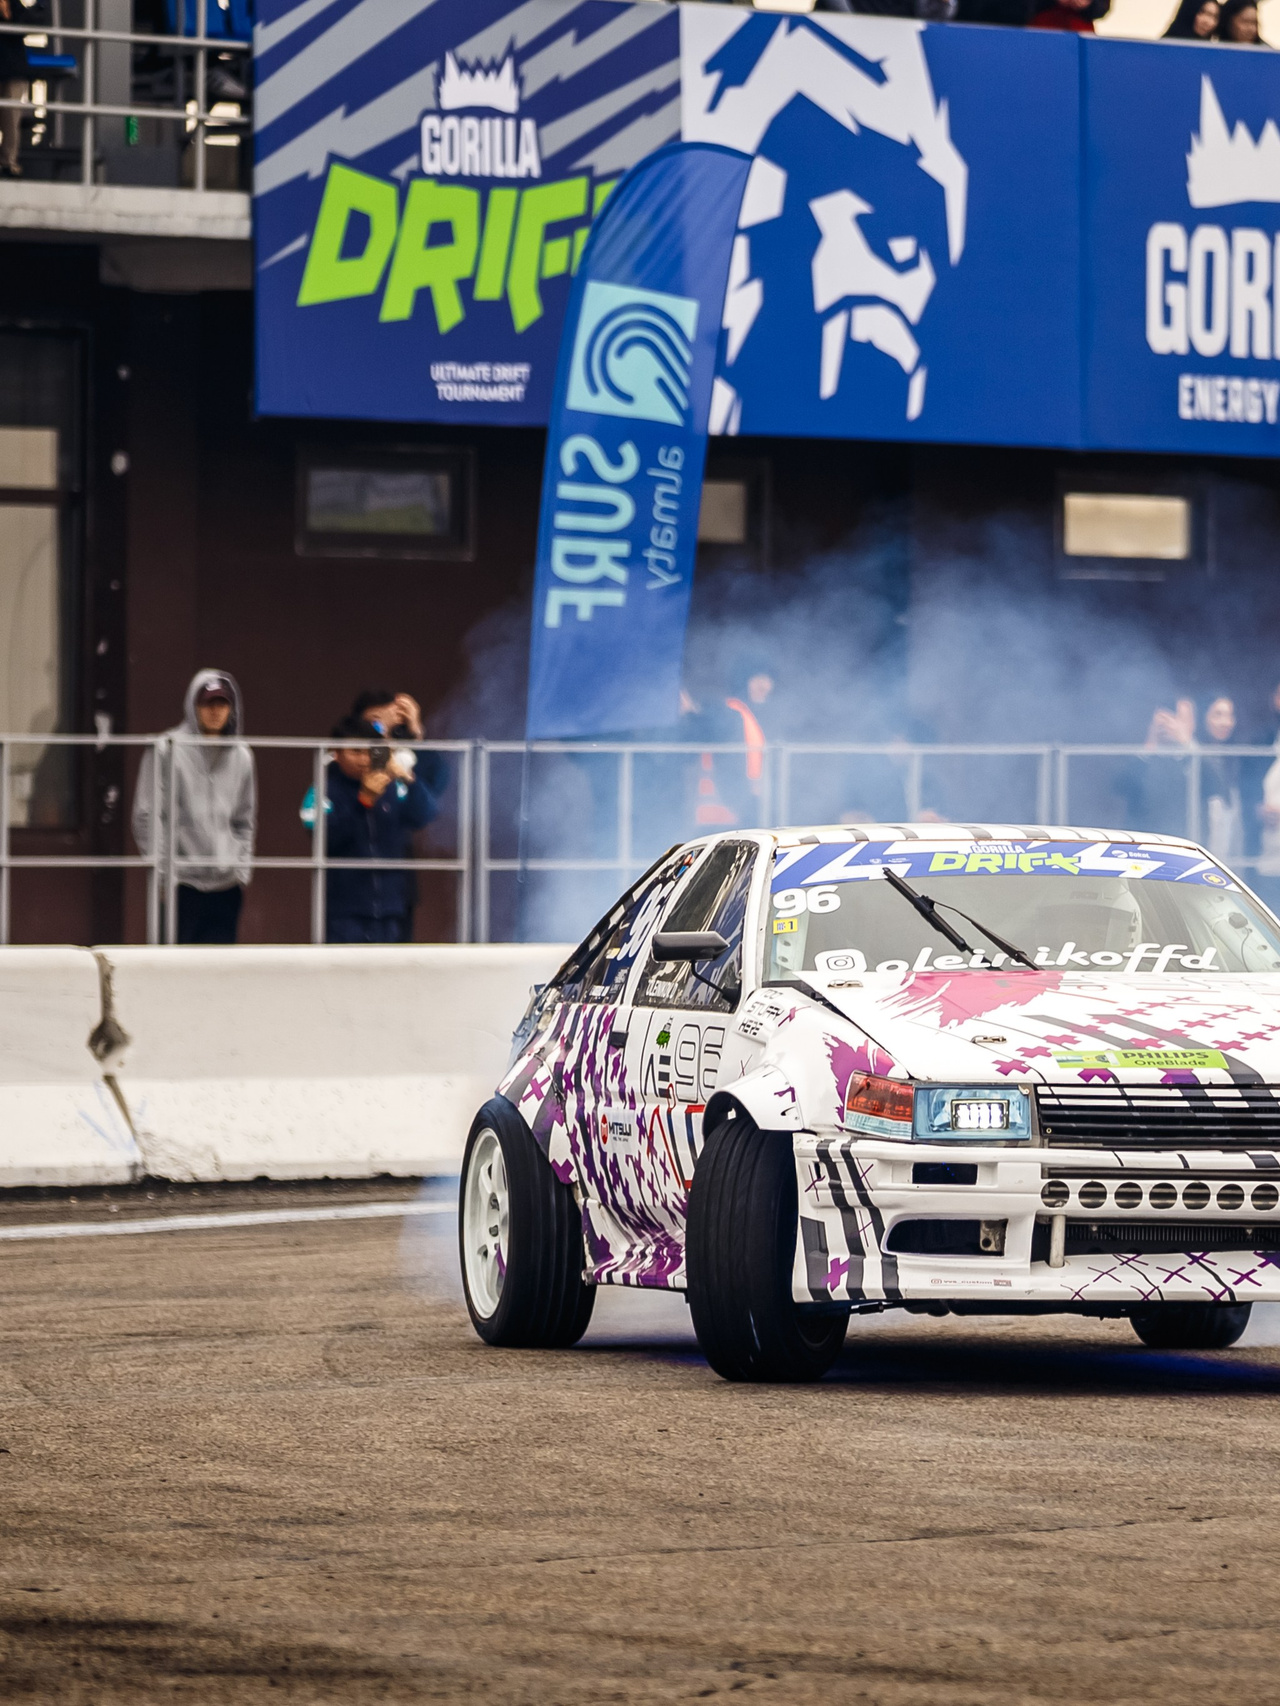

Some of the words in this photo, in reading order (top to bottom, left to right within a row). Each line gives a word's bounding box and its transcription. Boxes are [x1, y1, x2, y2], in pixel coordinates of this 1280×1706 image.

[421, 115, 541, 178] GORILLA
[430, 361, 491, 382] ULTIMATE
[492, 361, 531, 383] DRIFT
[436, 383, 525, 402] TOURNAMENT
[1178, 374, 1280, 424] ENERGY
[970, 845, 1026, 854] GORILLA
[773, 885, 841, 918] 96
[875, 942, 1220, 974] oleinikoffd
[1122, 1051, 1210, 1060] PHILIPS
[1134, 1059, 1206, 1067] OneBlade
